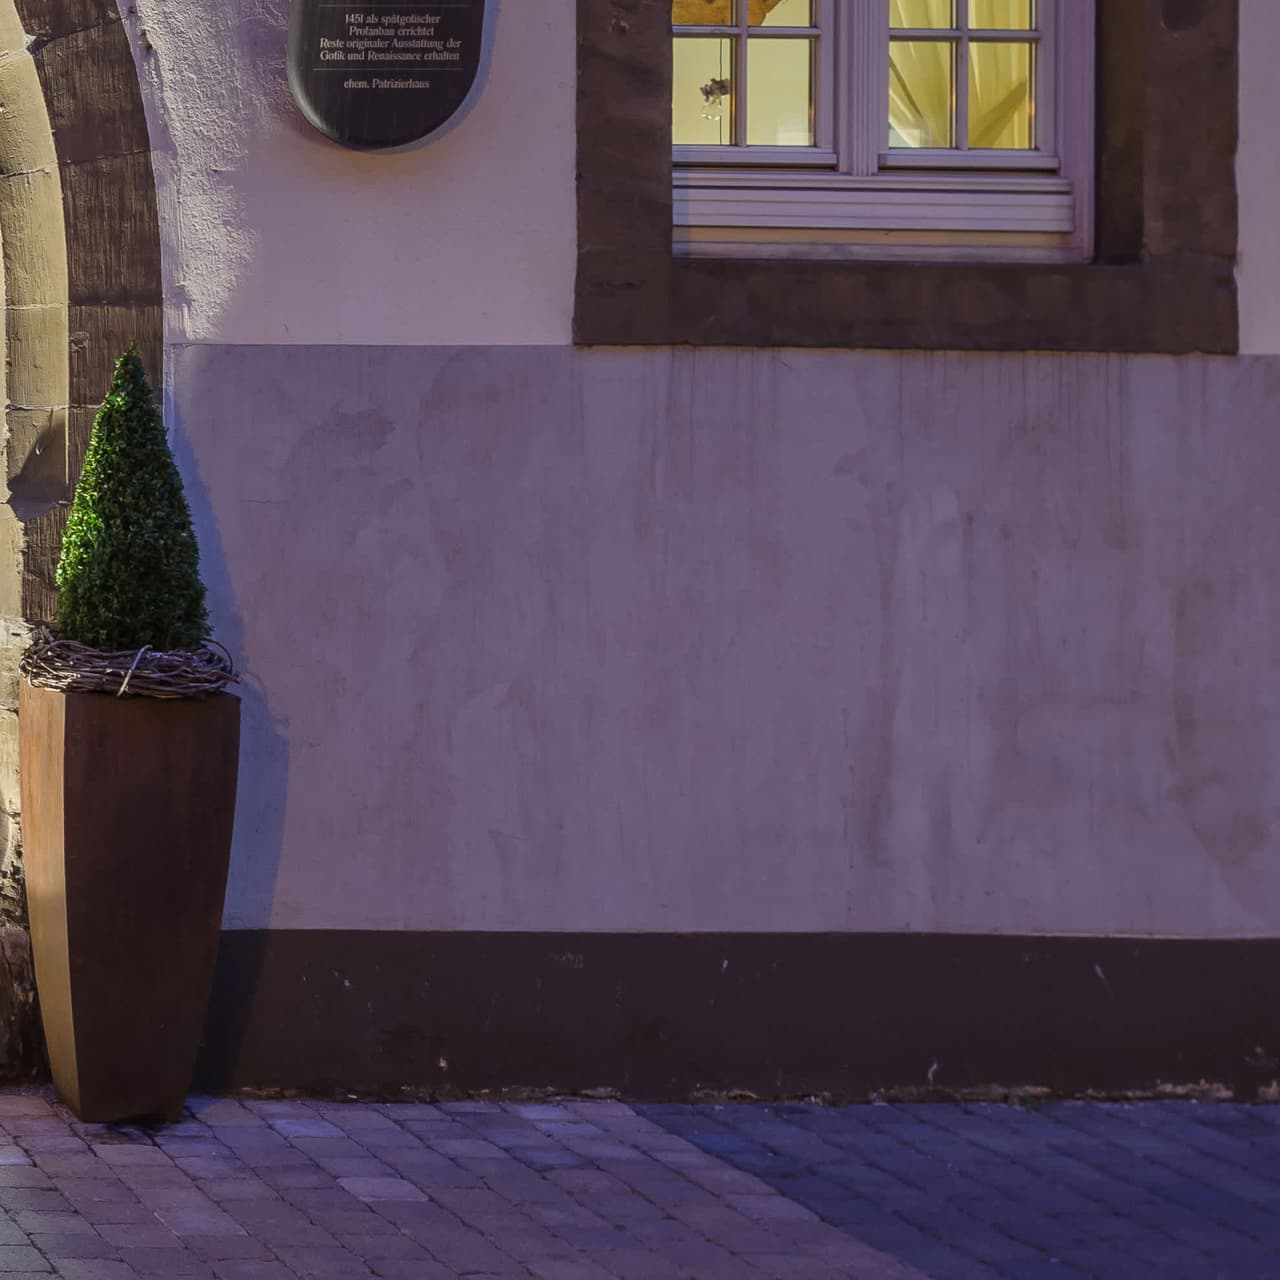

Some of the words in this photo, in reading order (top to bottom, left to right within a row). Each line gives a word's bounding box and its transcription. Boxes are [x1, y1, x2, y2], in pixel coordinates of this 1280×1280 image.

[345, 13, 364, 24] 1451
[365, 13, 379, 24] als
[380, 13, 441, 27] spätgotischer
[349, 25, 395, 36] Profanbau
[397, 26, 434, 36] errichtet
[320, 37, 345, 49] Reste
[346, 38, 390, 51] originaler
[391, 37, 444, 51] Ausstattung
[446, 37, 462, 49] der
[320, 49, 345, 61] Gotik
[347, 50, 365, 61] und
[367, 50, 421, 61] Renaissance
[423, 50, 460, 61] erhalten
[343, 77, 370, 89] ehem.
[371, 77, 431, 89] Patrizierhaus
